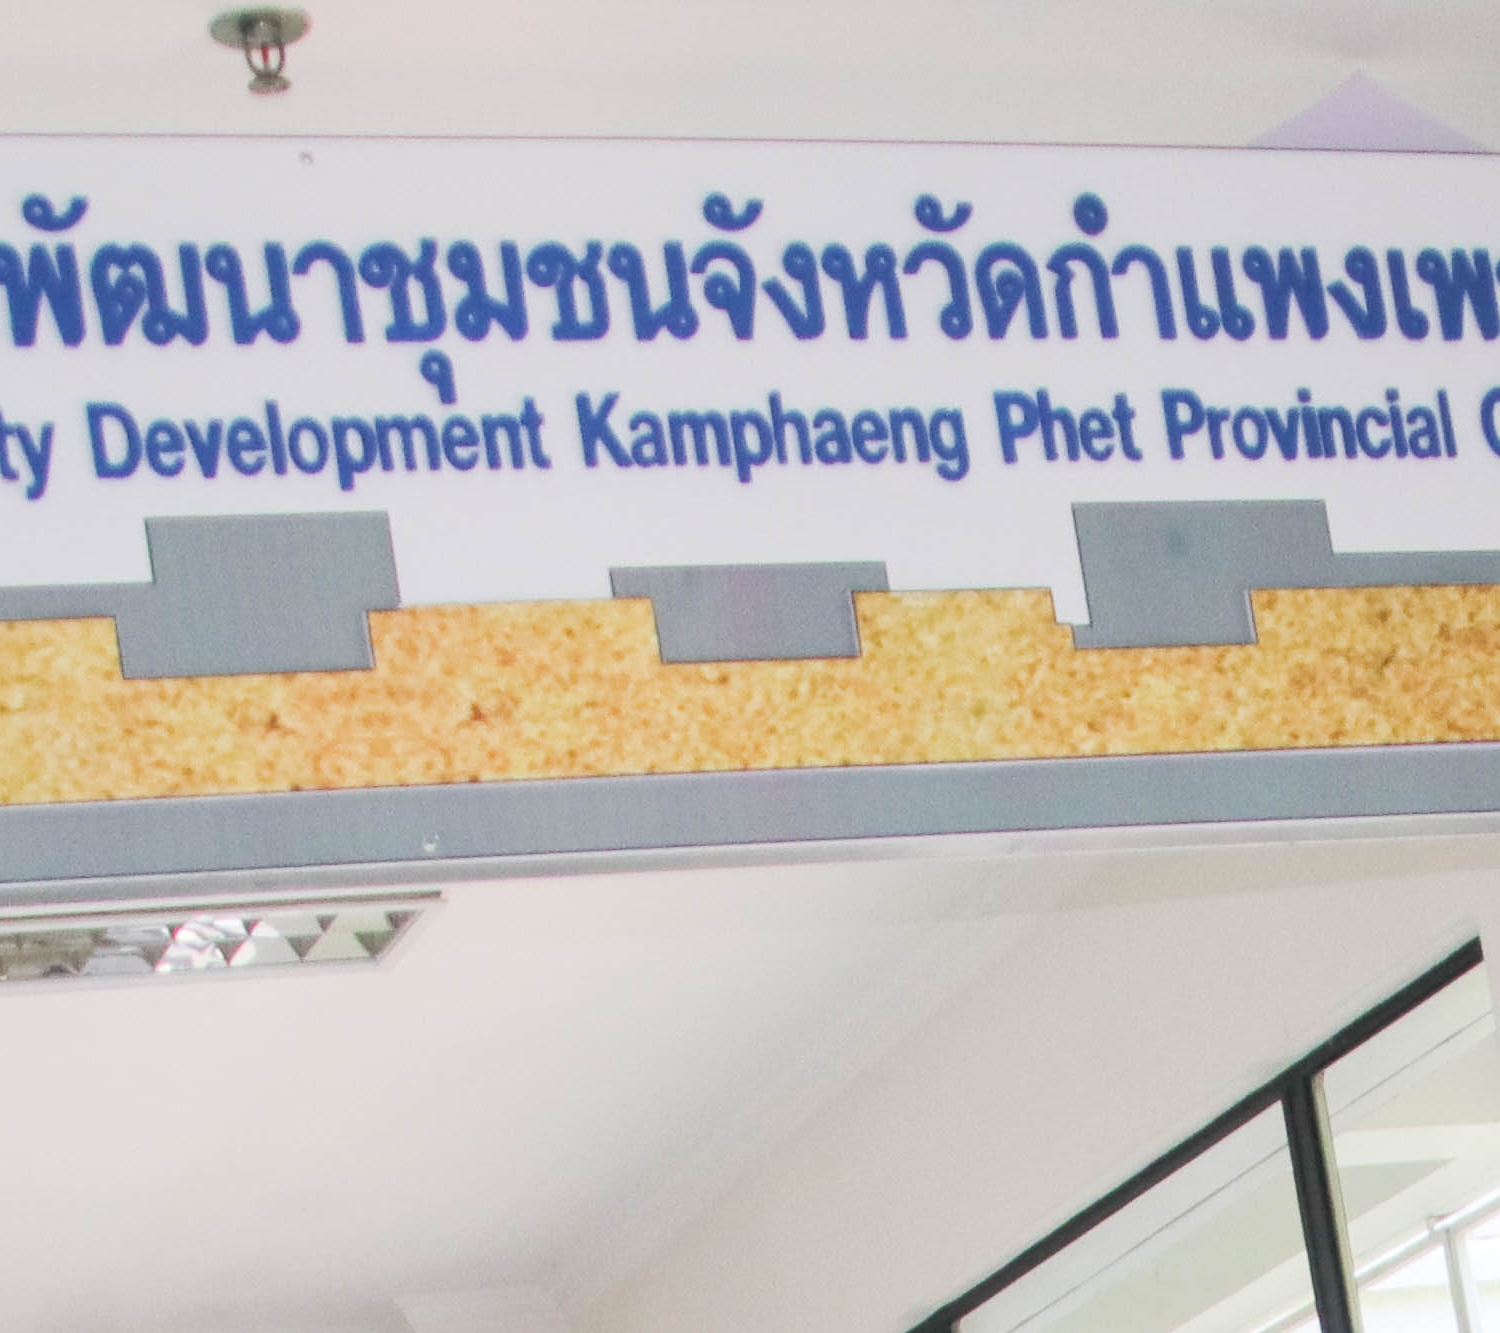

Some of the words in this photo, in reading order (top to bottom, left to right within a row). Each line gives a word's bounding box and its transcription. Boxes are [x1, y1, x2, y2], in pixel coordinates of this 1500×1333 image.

[84, 397, 550, 490] Development
[575, 391, 969, 482] Kamphaeng
[993, 389, 1141, 464] Phet
[1161, 389, 1455, 459] Provincial
